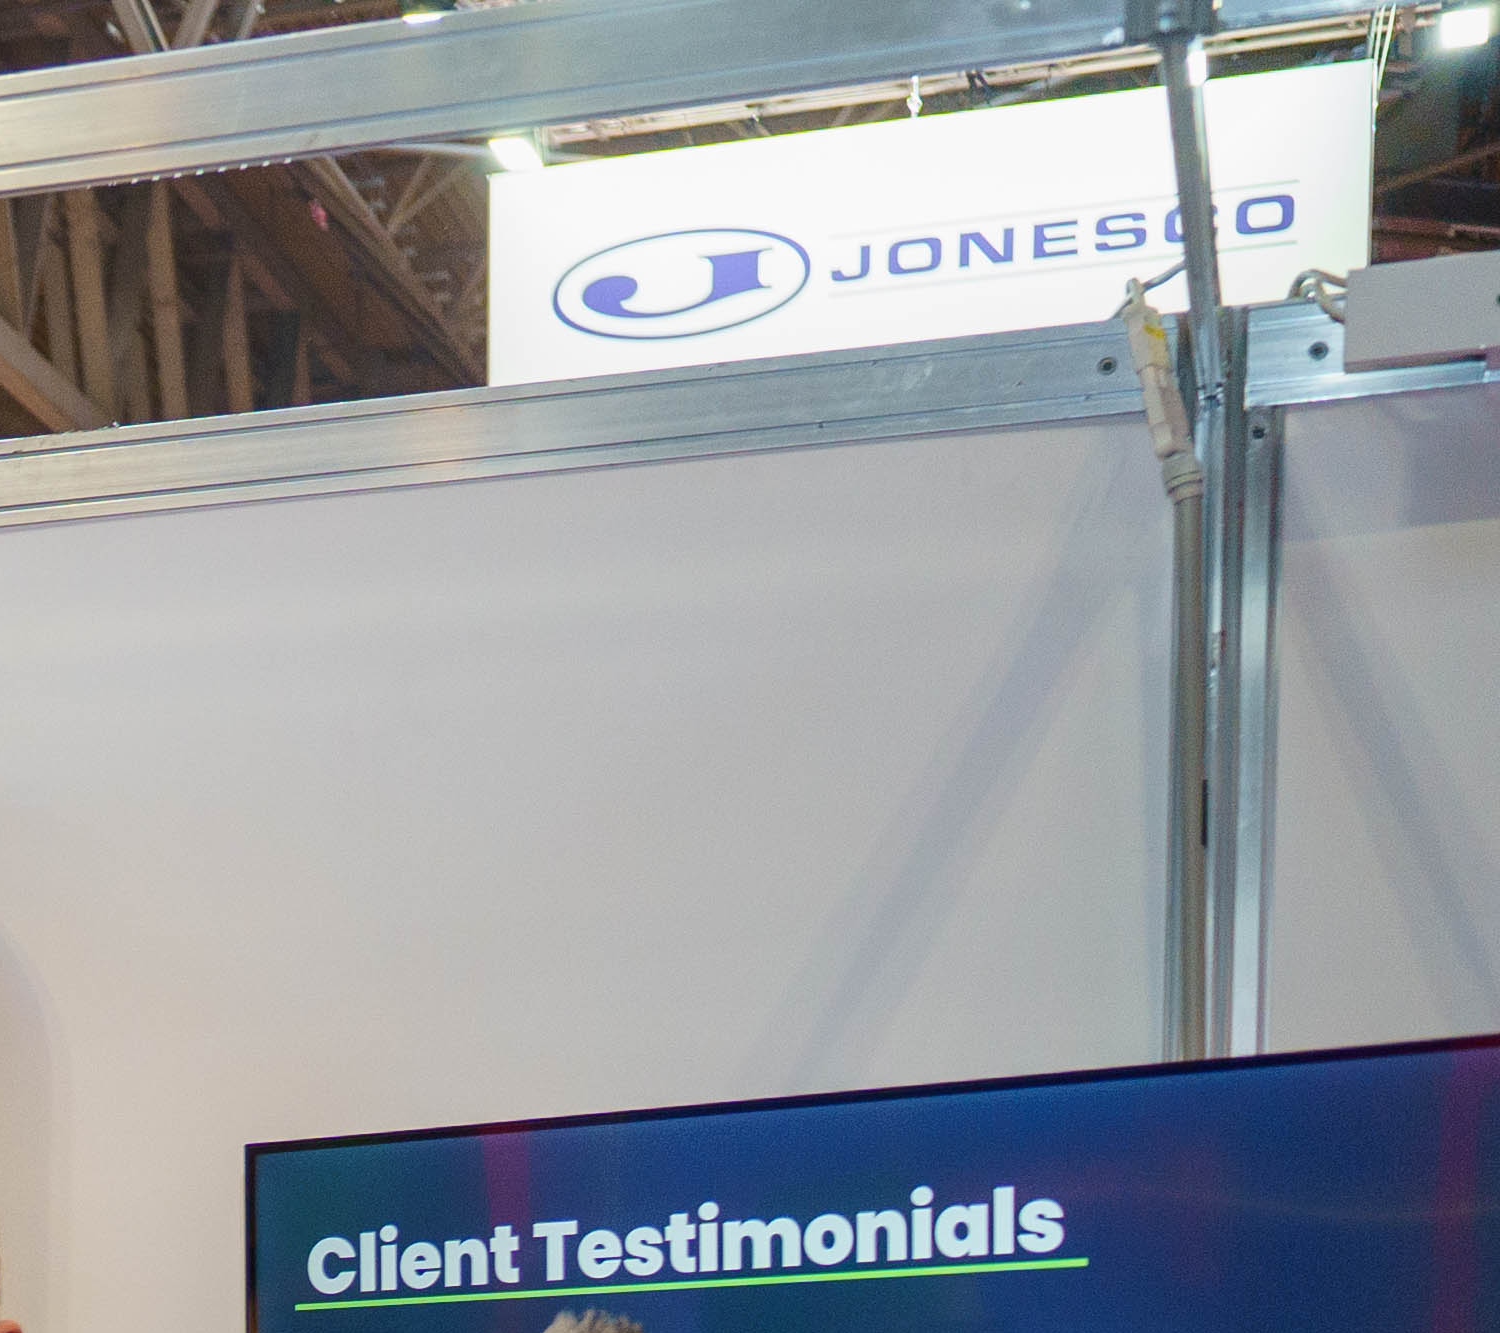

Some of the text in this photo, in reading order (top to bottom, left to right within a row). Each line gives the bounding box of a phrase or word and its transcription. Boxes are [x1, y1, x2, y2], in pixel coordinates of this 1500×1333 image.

[831, 193, 1297, 283] JONESO
[306, 1186, 1065, 1295] Client Testimonials
